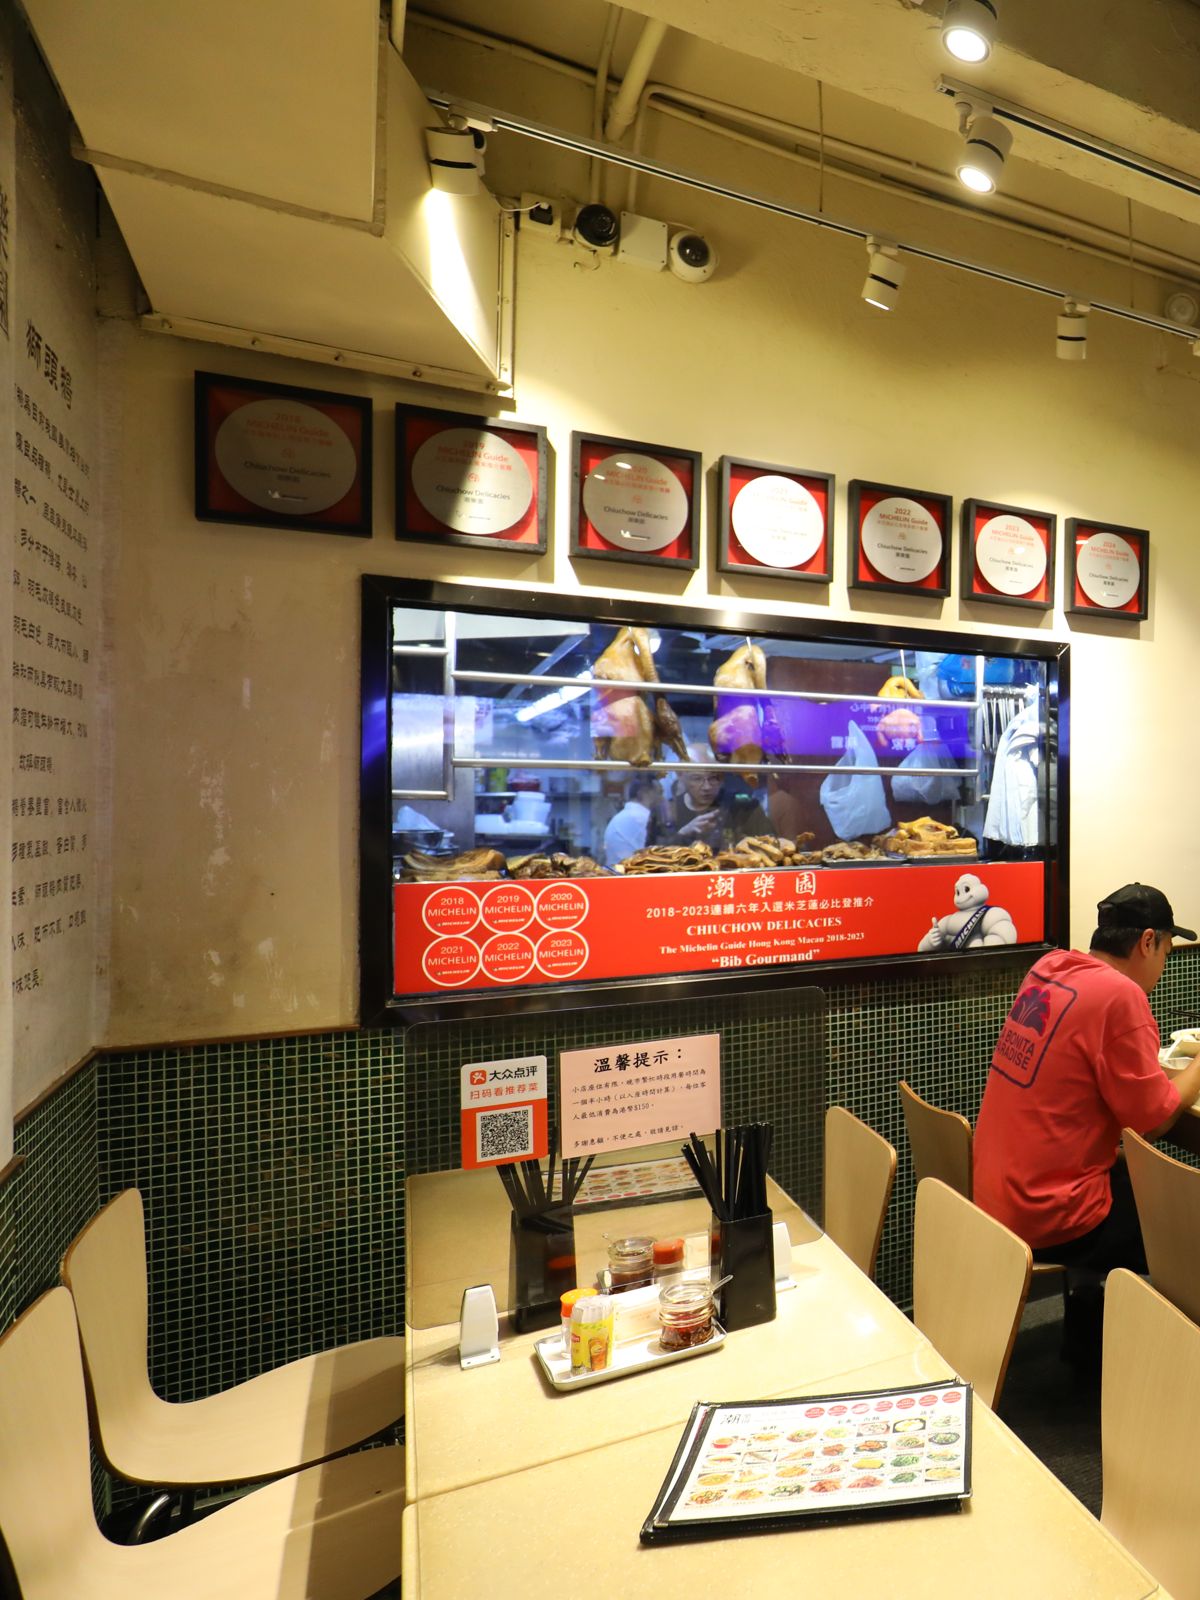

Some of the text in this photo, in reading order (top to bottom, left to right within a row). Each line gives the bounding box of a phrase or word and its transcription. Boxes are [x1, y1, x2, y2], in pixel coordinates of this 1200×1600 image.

[707, 871, 816, 899] 潮樂園
[441, 897, 464, 906] 2018
[497, 895, 520, 903] 2019
[551, 893, 573, 901] 2020
[484, 904, 532, 914] MICHELIN
[539, 902, 584, 911] MICHELIN
[428, 908, 477, 917] MICHELIN
[686, 917, 842, 936] CHIUCHOW DELICACIES
[497, 943, 520, 951] 2022
[551, 939, 573, 947] 2023
[660, 932, 865, 954] The Michelin Guide Hong Kong Macau 2018-2023
[441, 946, 463, 954] 2021
[539, 948, 584, 958] MICHELIN
[428, 956, 477, 966] MICHELIN
[484, 952, 532, 962] MICHELIN
[1005, 1029, 1035, 1057] BONITA
[489, 1065, 538, 1082] 大众点评
[470, 1082, 539, 1100] 扫码看推荐菜
